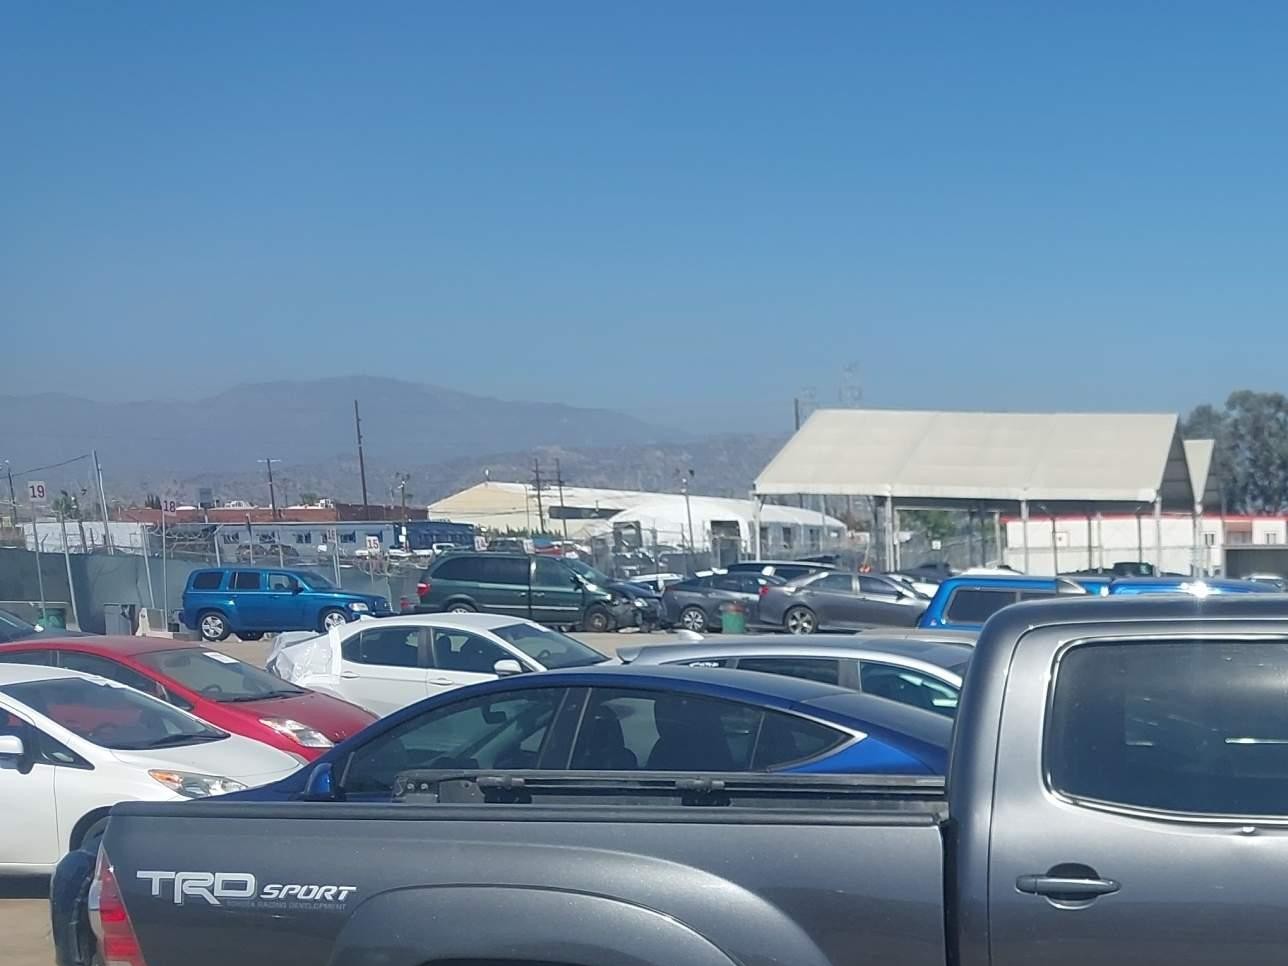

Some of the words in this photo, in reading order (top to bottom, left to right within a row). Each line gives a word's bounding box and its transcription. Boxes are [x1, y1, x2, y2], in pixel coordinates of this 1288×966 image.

[29, 485, 45, 498] 19
[163, 500, 176, 513] 18
[136, 870, 255, 905] TRD
[260, 884, 357, 900] SPORT
